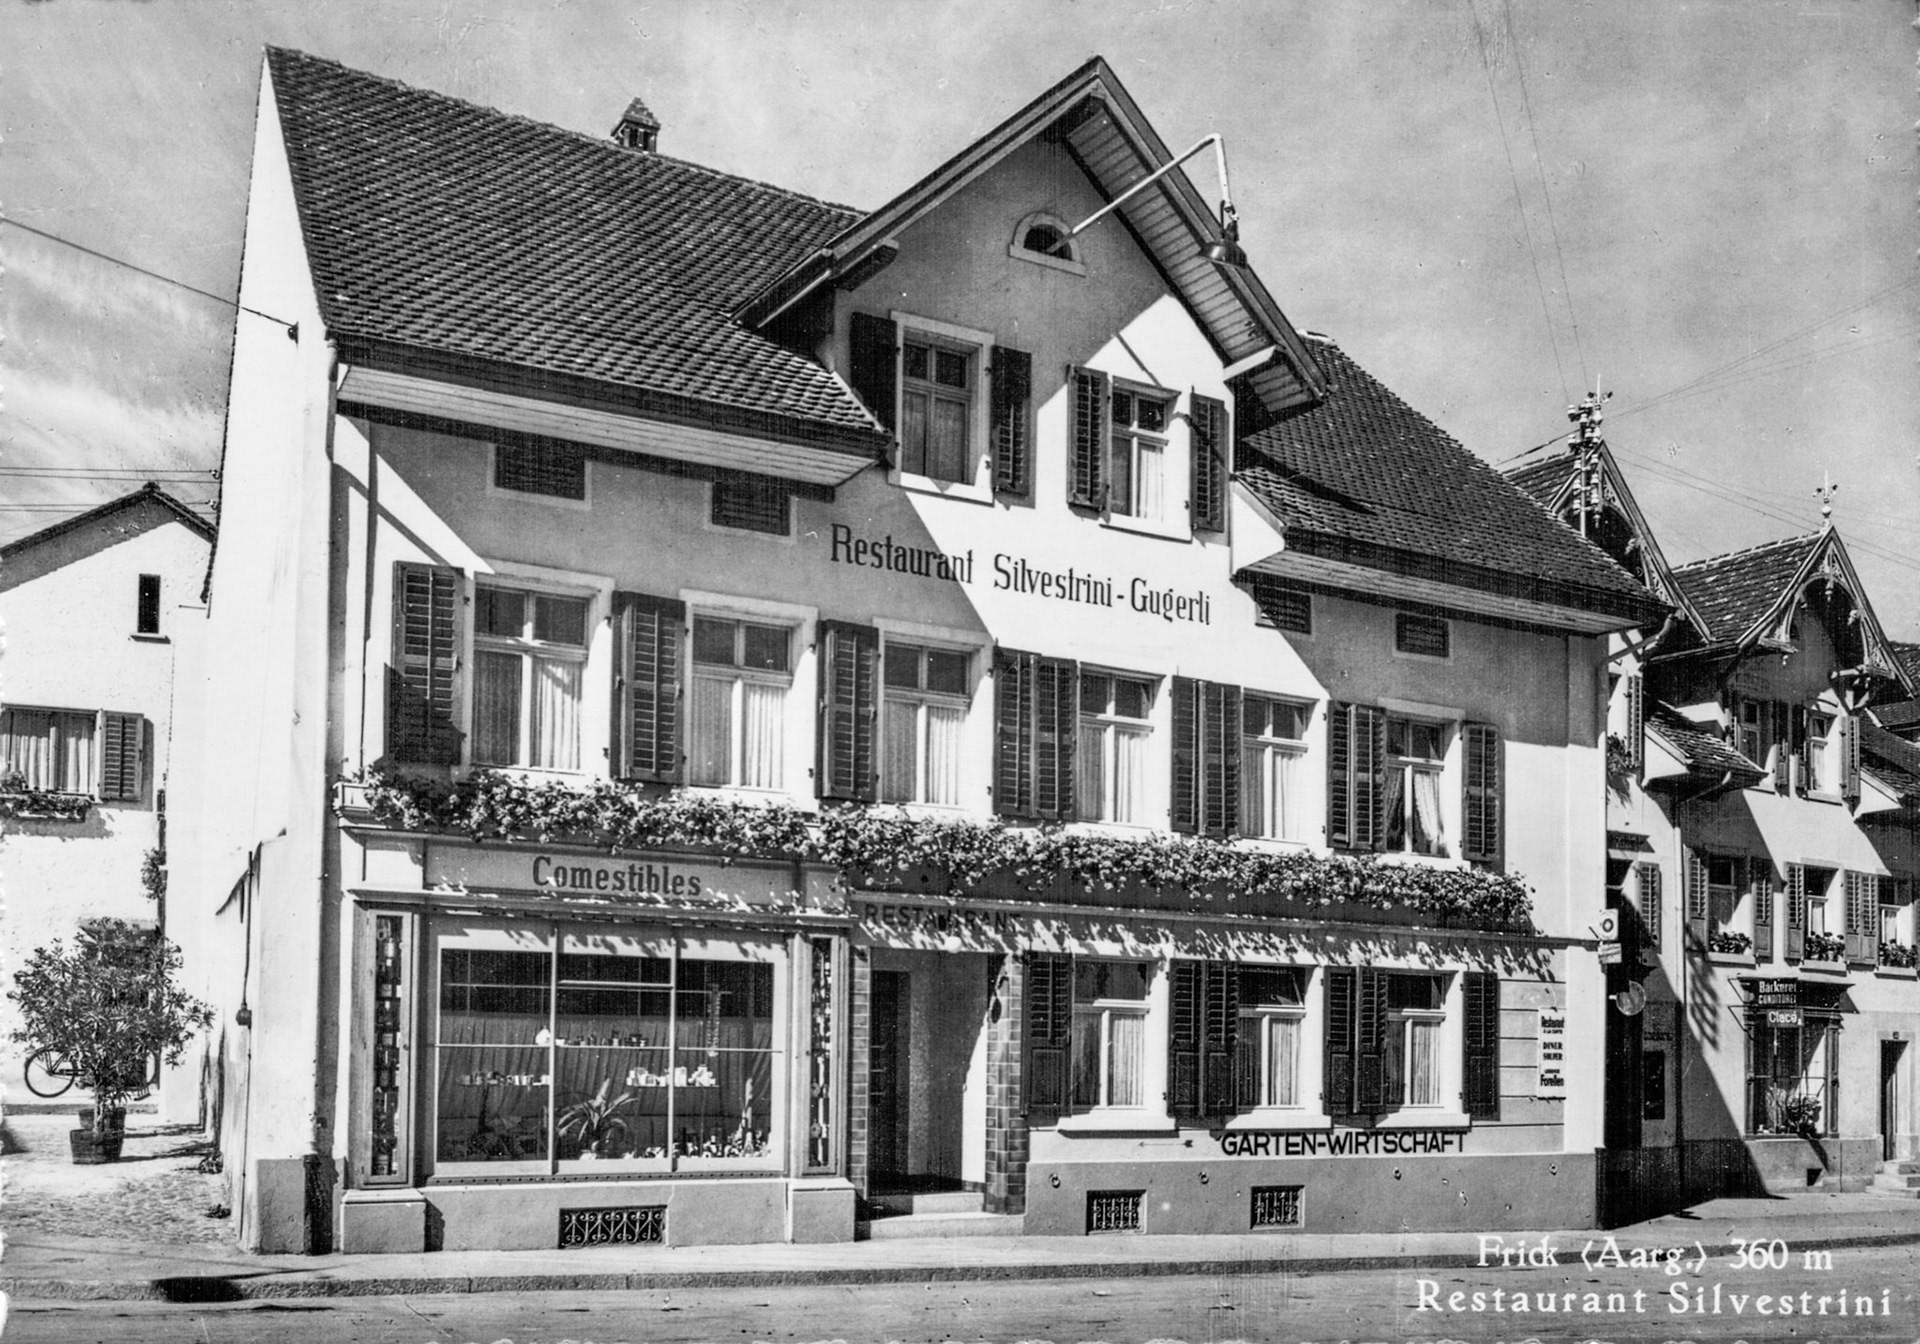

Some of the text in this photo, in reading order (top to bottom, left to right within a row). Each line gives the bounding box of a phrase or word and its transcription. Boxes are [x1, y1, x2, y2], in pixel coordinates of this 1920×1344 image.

[830, 523, 974, 584] Restaurant
[532, 855, 701, 896] Comestibles
[1221, 1131, 1467, 1156] GARTEN-WIRTSCHAFT
